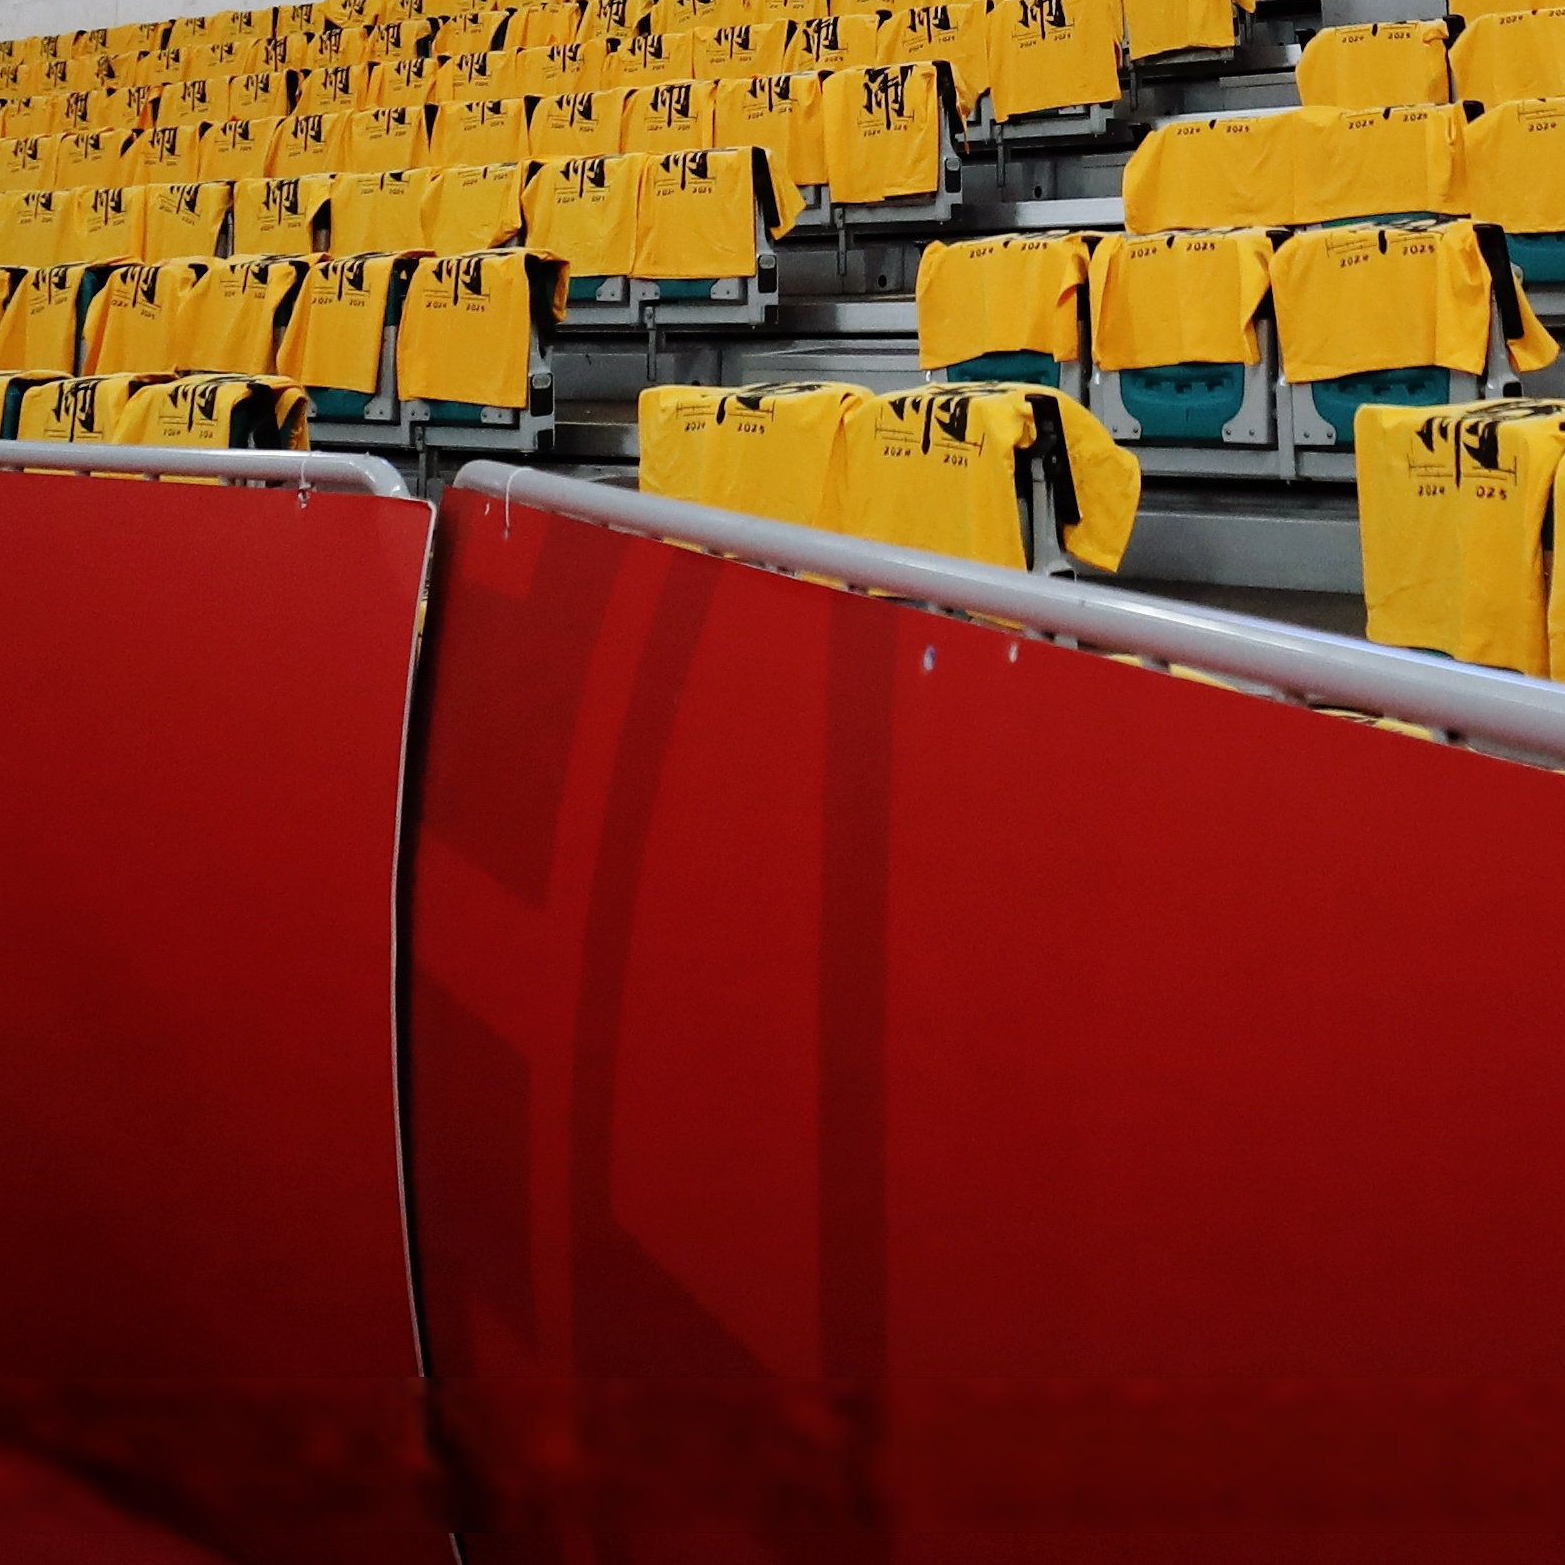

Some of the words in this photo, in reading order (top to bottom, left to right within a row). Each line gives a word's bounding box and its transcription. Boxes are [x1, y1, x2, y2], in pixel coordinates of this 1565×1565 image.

[1403, 243, 1434, 255] 2025
[737, 423, 765, 434] 2025
[885, 446, 911, 457] 2024
[1418, 486, 1445, 496] 2024
